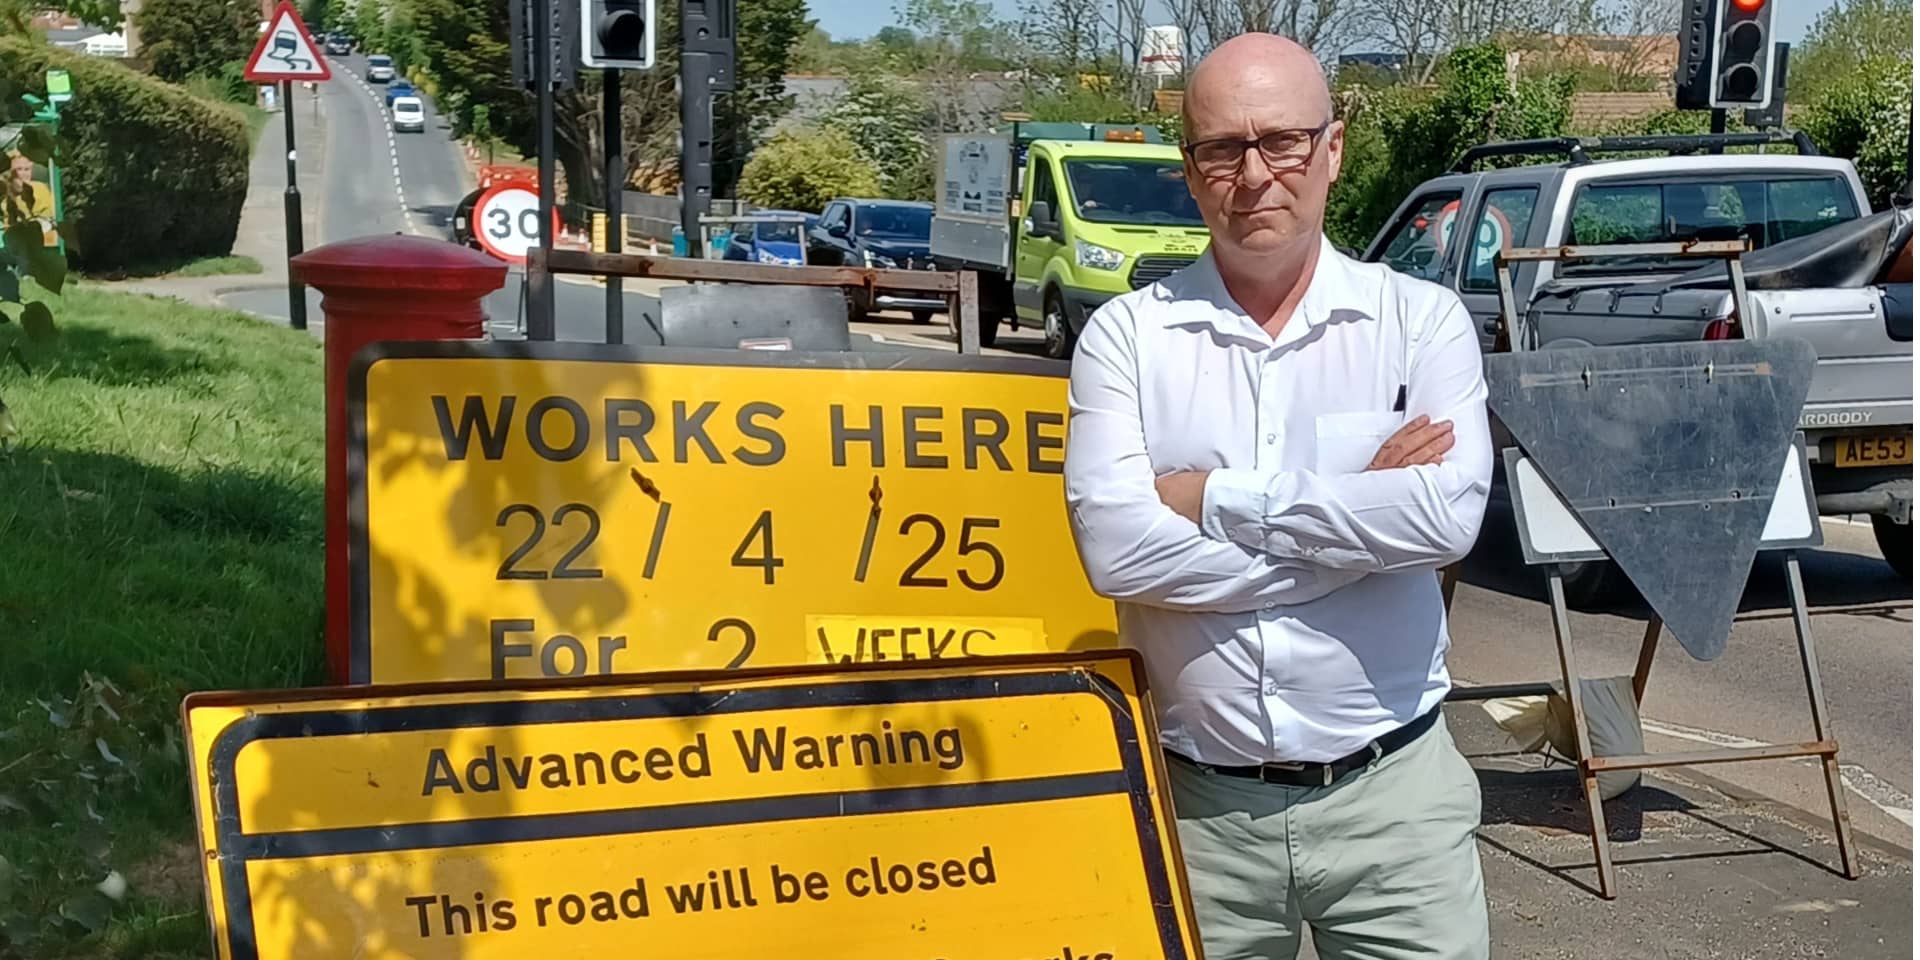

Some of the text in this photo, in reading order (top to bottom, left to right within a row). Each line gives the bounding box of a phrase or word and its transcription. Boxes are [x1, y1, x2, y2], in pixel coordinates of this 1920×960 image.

[487, 207, 541, 239] 30
[430, 393, 1065, 474] WORKS HERE
[1845, 437, 1906, 462] AE53
[495, 502, 604, 581] 22
[730, 510, 785, 586] 4
[898, 513, 1005, 592] 25
[490, 618, 627, 681] For
[420, 719, 965, 798] Advanced Warning
[405, 846, 997, 937] This road will be closed
